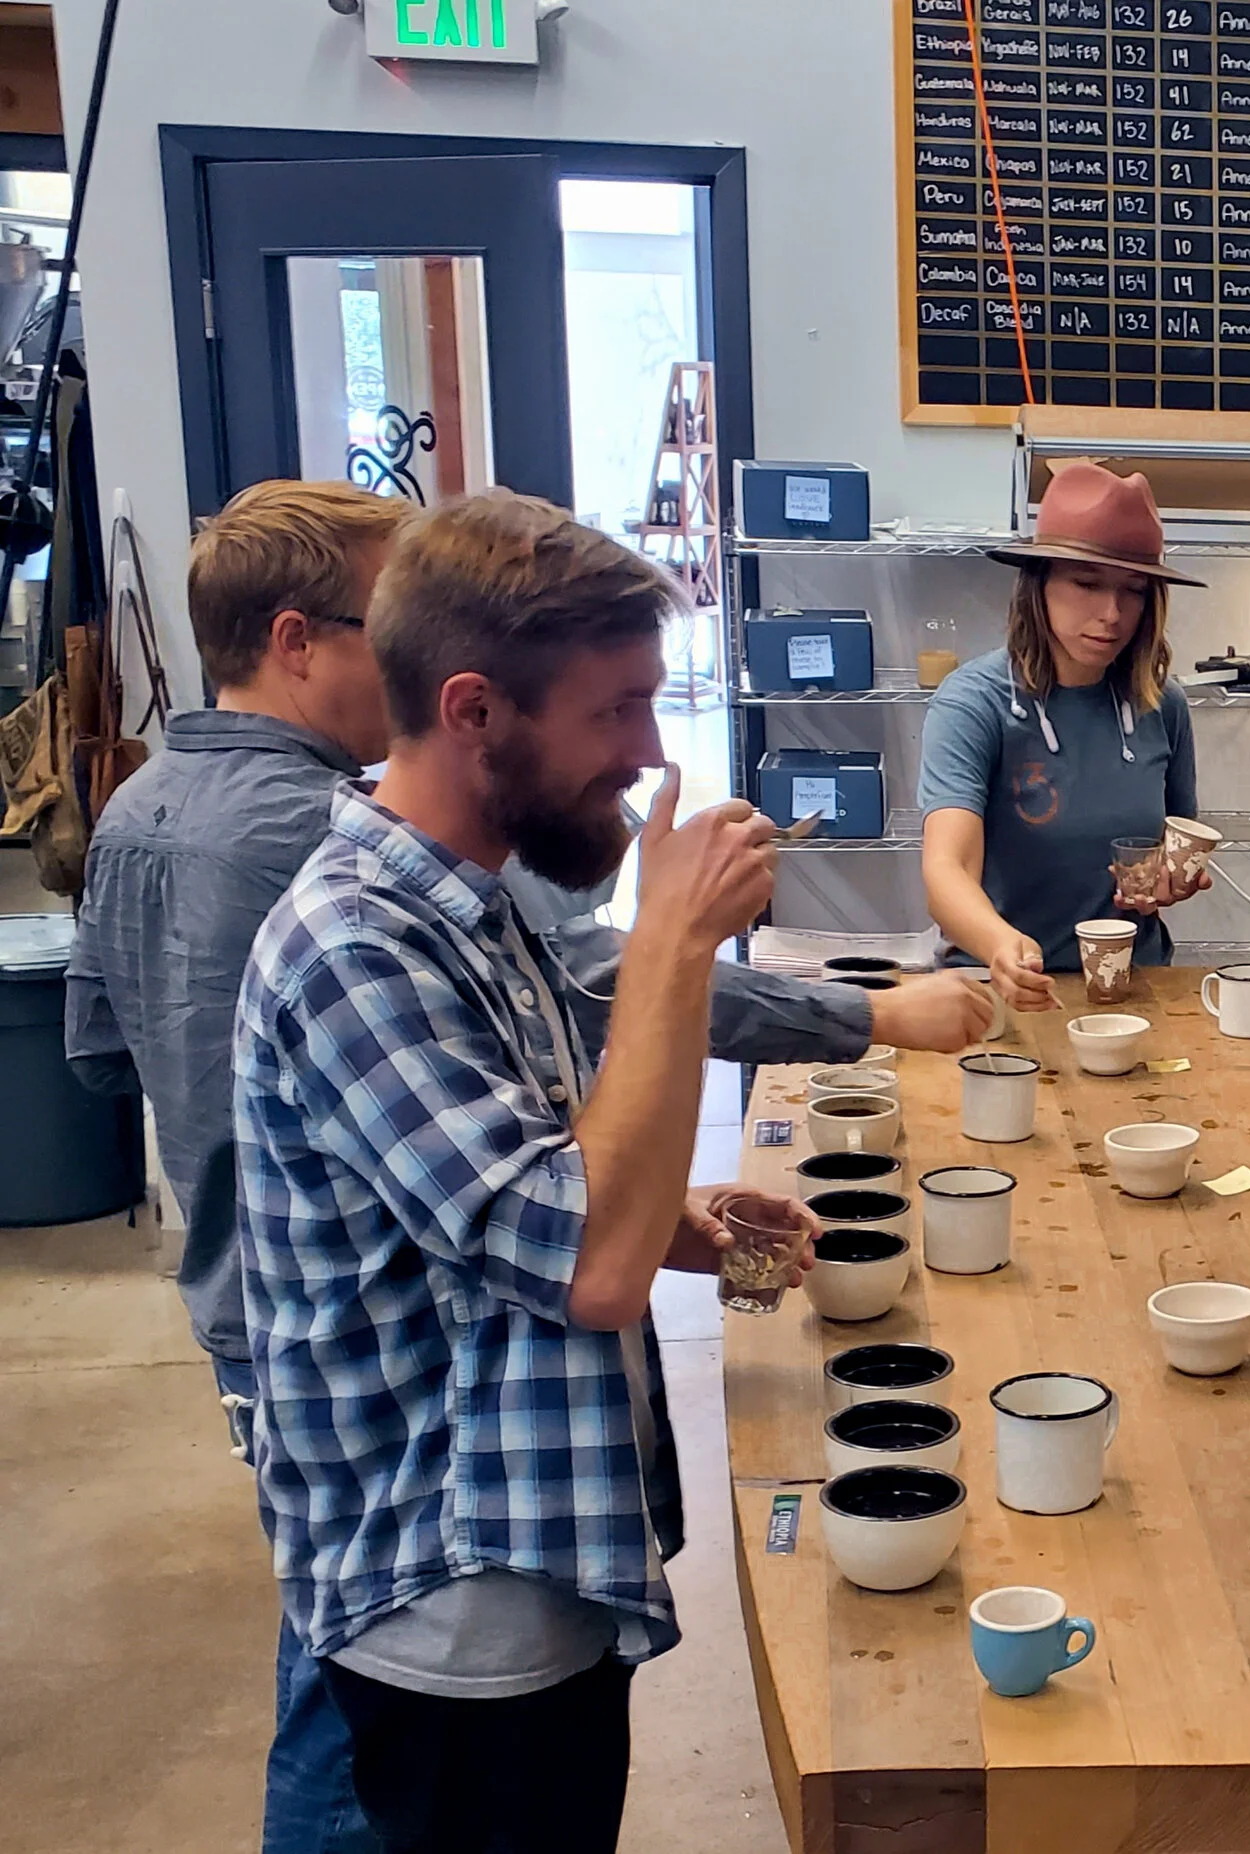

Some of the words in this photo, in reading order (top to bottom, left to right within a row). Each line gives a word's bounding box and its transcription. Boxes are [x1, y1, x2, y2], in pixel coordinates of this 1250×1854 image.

[984, 5, 1032, 21] Gerais
[1114, 5, 1145, 26] 132
[1166, 9, 1193, 28] 26
[1115, 46, 1146, 66] 132
[1172, 48, 1190, 68] 14
[1115, 82, 1145, 103] 152
[1169, 85, 1189, 105] 41
[915, 112, 972, 128] Honduras
[1117, 120, 1147, 140] 152
[1170, 121, 1195, 141] 62
[918, 151, 970, 168] Mexico
[1118, 160, 1148, 181] 152
[1170, 163, 1191, 184] 21
[923, 185, 964, 205] Peru
[1117, 196, 1148, 215] 152
[1174, 201, 1193, 220] 15
[1118, 236, 1147, 256] 132
[1174, 238, 1192, 255] 10
[918, 263, 977, 283] Colombia
[1119, 273, 1147, 292] 154
[1173, 276, 1193, 296] 14
[921, 302, 972, 323] Decaf
[1059, 306, 1092, 335] N/A
[1118, 313, 1150, 331] 132
[1167, 310, 1200, 338] N/A
